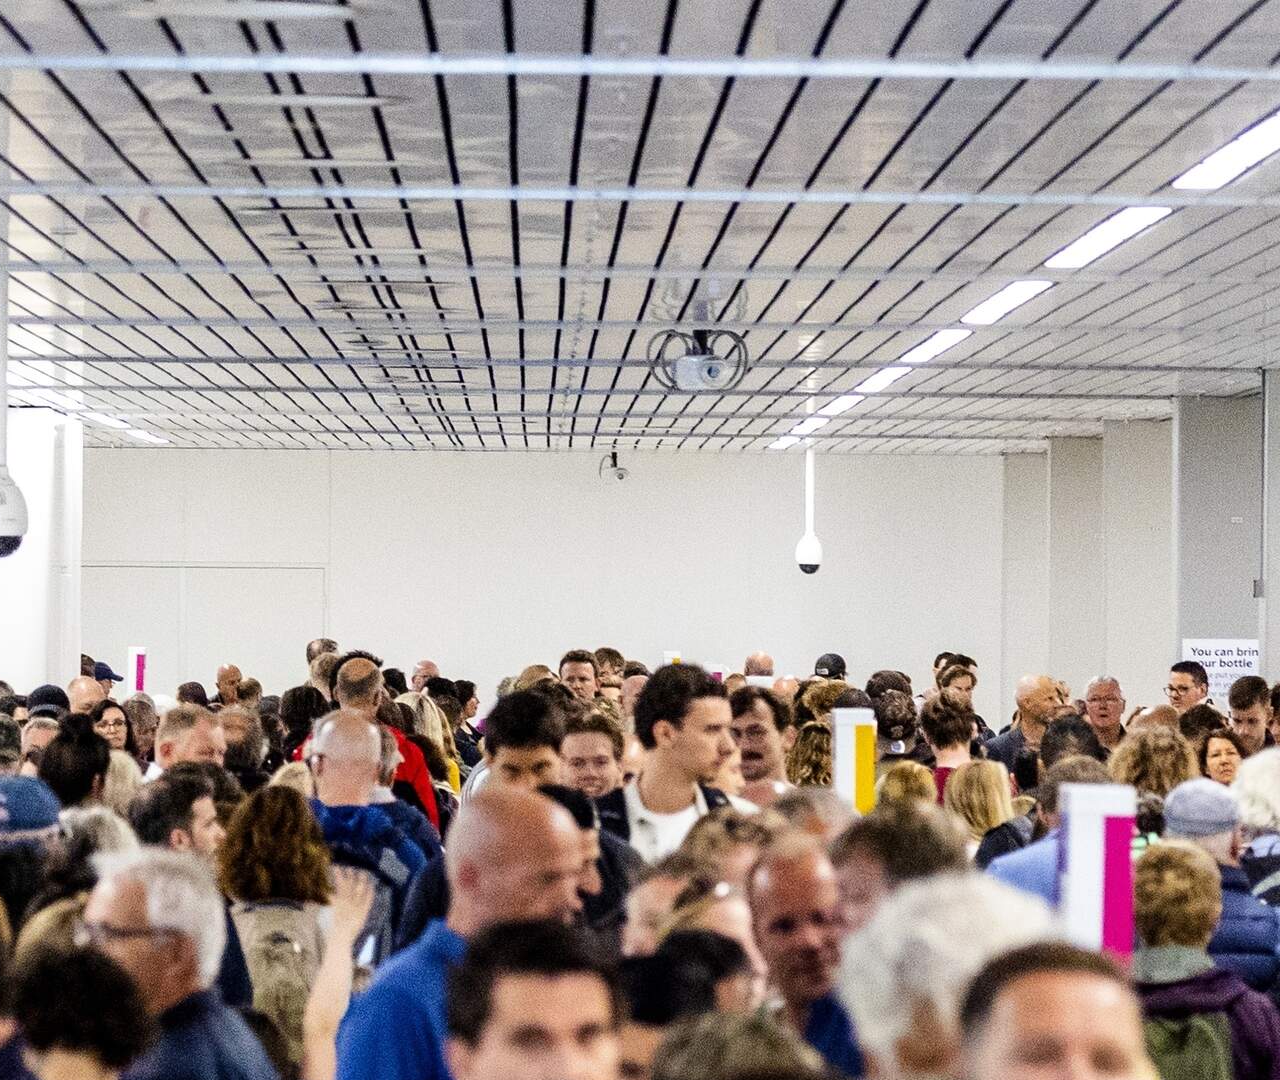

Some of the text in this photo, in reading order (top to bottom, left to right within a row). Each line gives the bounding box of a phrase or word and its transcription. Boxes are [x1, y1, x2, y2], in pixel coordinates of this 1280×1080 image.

[1191, 647, 1212, 656] You
[1237, 647, 1259, 656] brin
[1219, 658, 1253, 668] bottle
